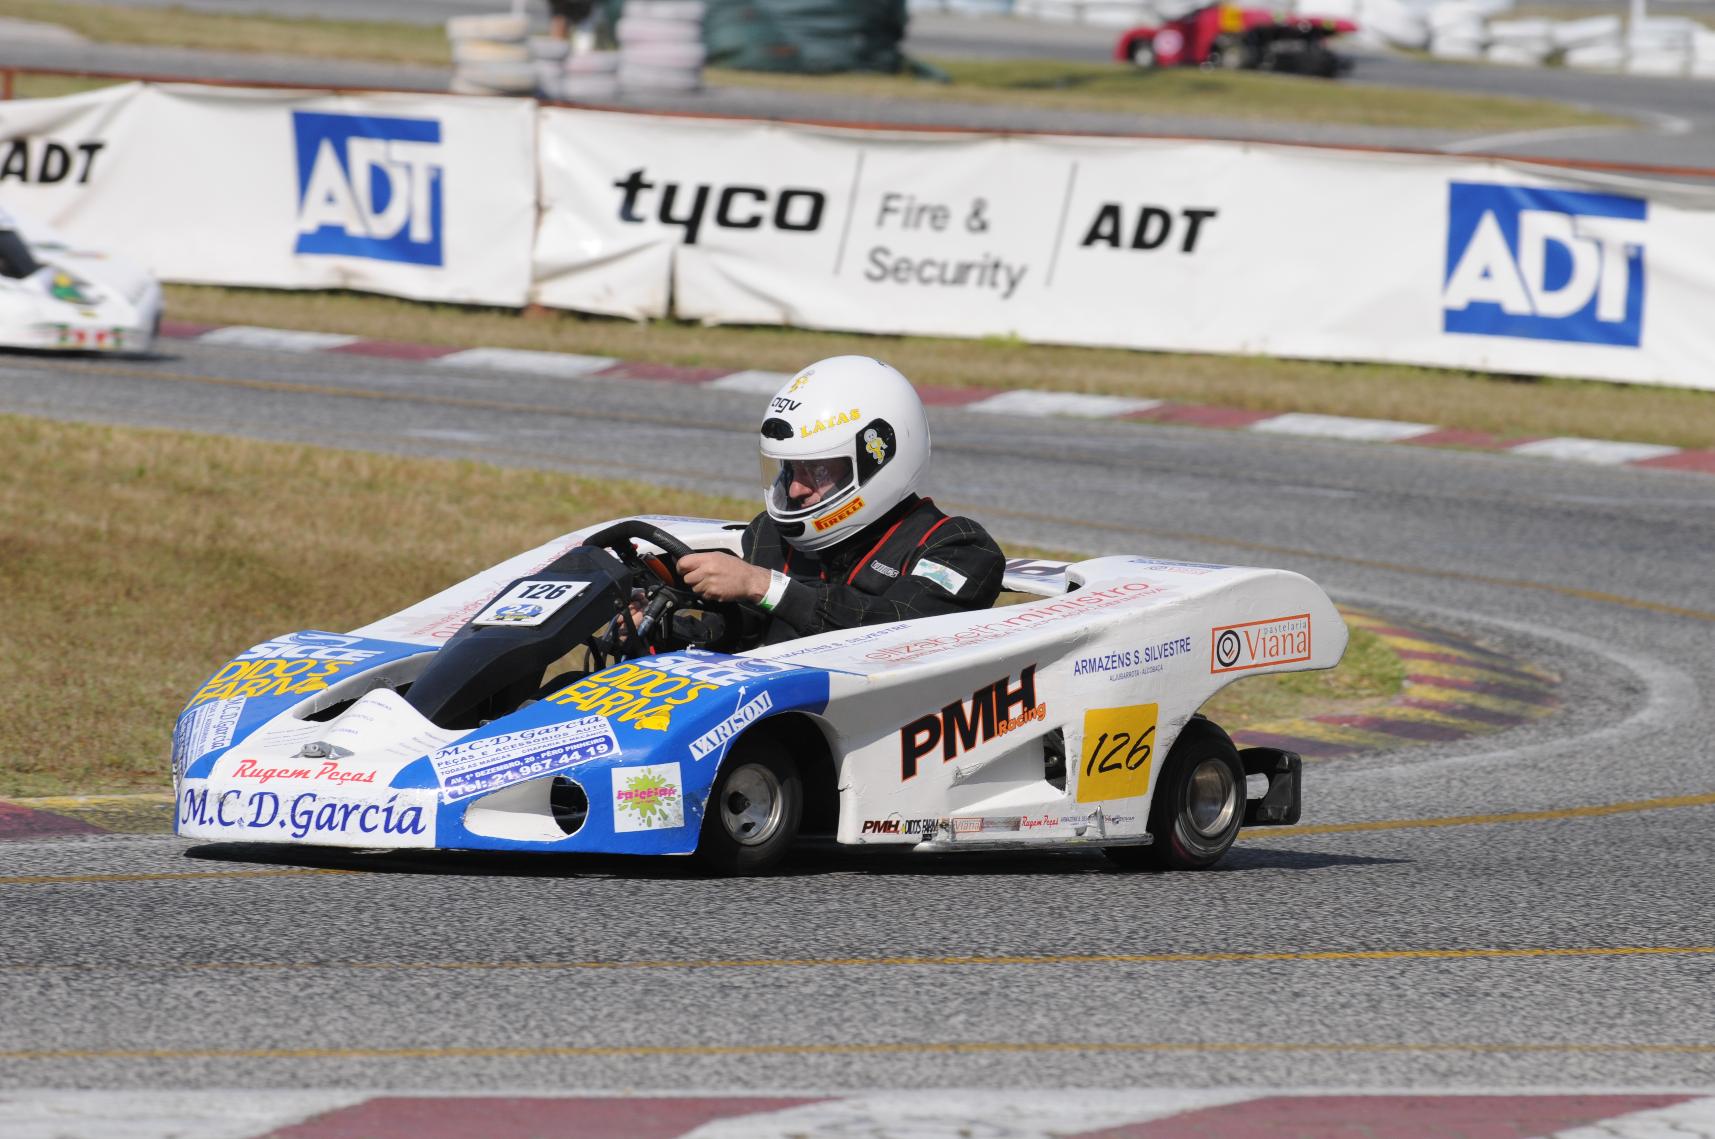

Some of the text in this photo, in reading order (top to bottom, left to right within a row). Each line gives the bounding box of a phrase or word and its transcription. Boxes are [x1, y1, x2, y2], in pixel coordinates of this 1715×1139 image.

[1, 139, 105, 184] ADT
[299, 136, 443, 243] ADT
[612, 168, 828, 245] tyco
[877, 193, 991, 234] Fire &
[1079, 202, 1219, 254] ADT
[864, 246, 1028, 299] Security
[1443, 209, 1650, 322] ADT
[771, 397, 802, 413] agv
[814, 497, 864, 531] PIRELLI
[517, 583, 573, 599] 126
[1243, 628, 1307, 660] Viana
[1264, 620, 1307, 634] pastelaria
[236, 643, 385, 661] SICCE
[1073, 636, 1191, 676] ARMAZÉNS S. SILVESTRE
[207, 659, 354, 685] DIDO'S
[589, 663, 720, 704] DIDO'S
[577, 723, 607, 734] AUTO
[692, 693, 771, 754] VARISOM
[901, 664, 1037, 782] PMH
[998, 702, 1047, 737] Racing
[518, 758, 553, 776] 967
[558, 750, 582, 764] 44
[586, 743, 609, 757] 19
[1087, 725, 1156, 776] 126
[232, 759, 378, 786] Rugem Peças
[862, 820, 899, 834] PMH
